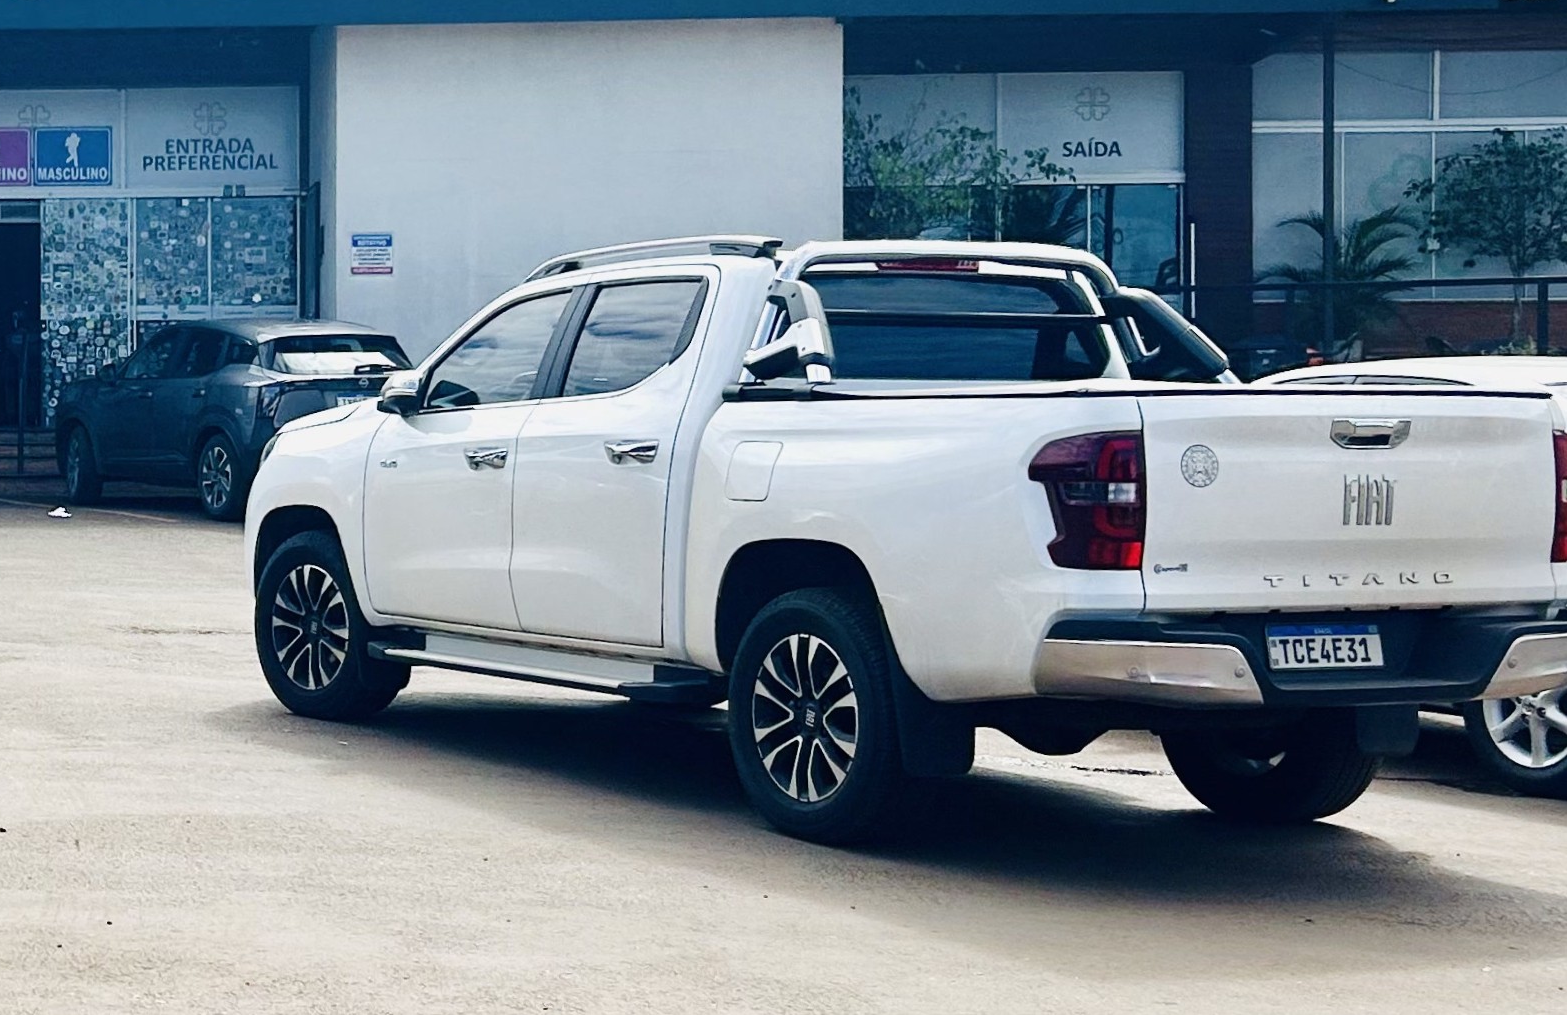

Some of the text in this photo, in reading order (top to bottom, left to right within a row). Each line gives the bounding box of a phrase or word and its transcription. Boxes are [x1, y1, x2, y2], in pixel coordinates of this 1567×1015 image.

[165, 137, 255, 155] ENTRADA
[1062, 137, 1122, 158] SAÍDA
[142, 153, 279, 172] PREFERENCIAL
[37, 167, 108, 181] MASCULINO
[1343, 474, 1397, 525] FIAT
[1264, 571, 1454, 587] TITANO
[1278, 637, 1372, 663] TCE4E31
